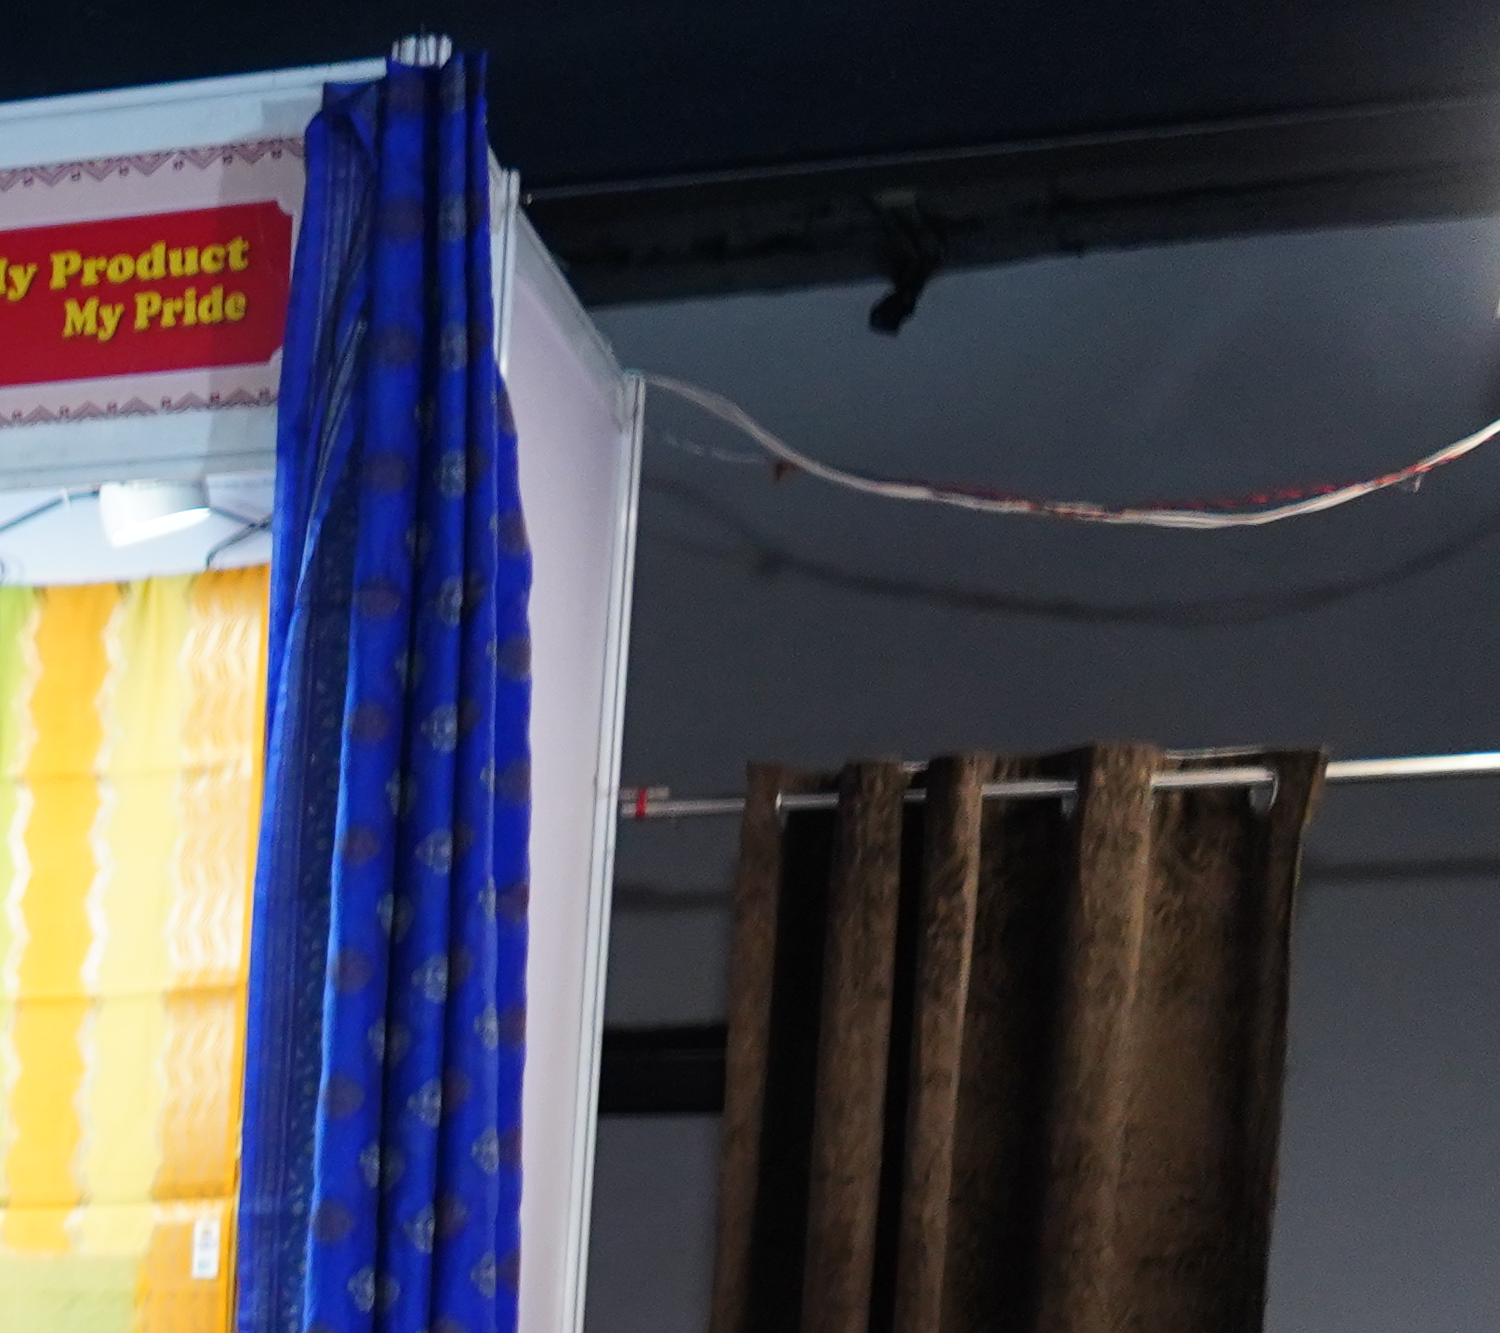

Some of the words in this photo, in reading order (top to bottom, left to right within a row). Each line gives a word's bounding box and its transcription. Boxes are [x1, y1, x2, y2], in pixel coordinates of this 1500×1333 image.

[49, 236, 250, 290] Product
[62, 296, 125, 342] My
[133, 284, 247, 331] Pride
